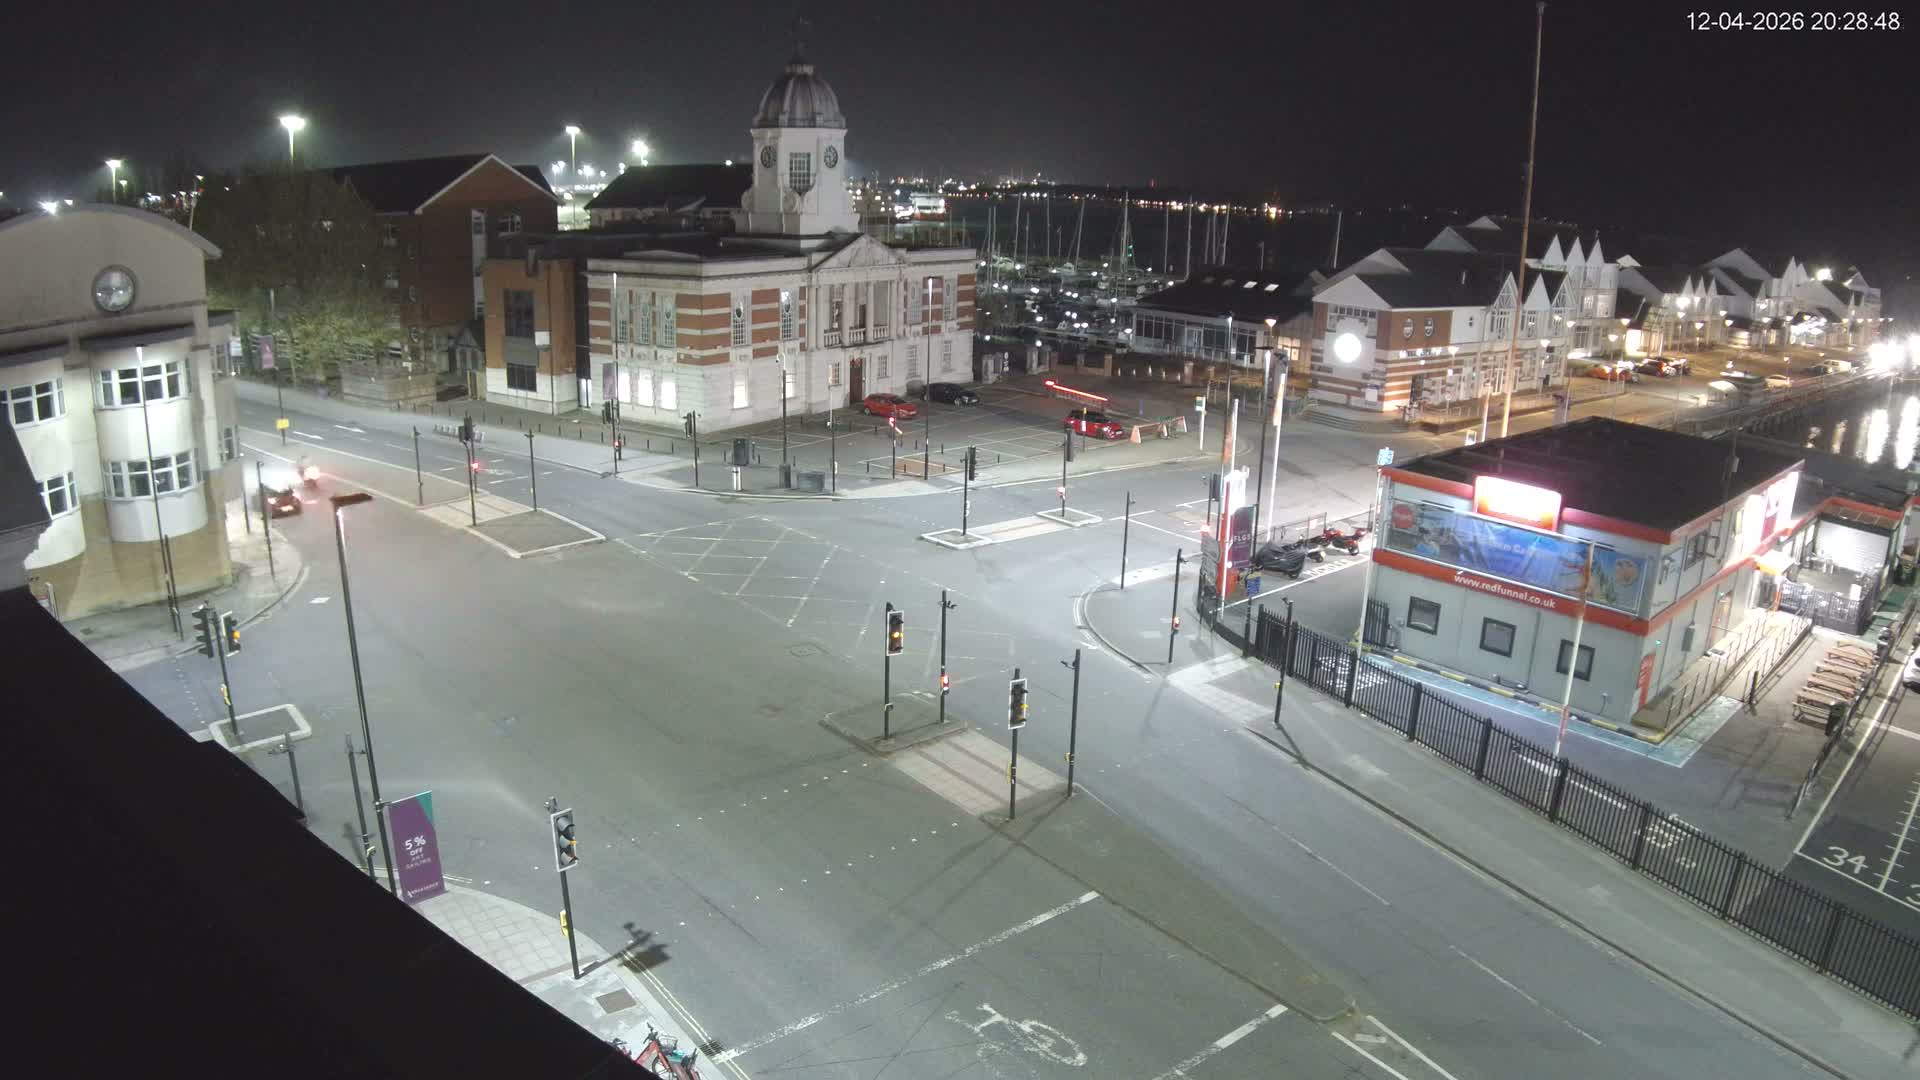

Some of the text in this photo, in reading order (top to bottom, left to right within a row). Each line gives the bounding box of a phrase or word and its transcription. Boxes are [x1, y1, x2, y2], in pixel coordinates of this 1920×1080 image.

[1454, 575, 1556, 608] www.redfunnel.co.uk
[410, 847, 423, 856] OFF
[1823, 846, 1869, 874] 34
